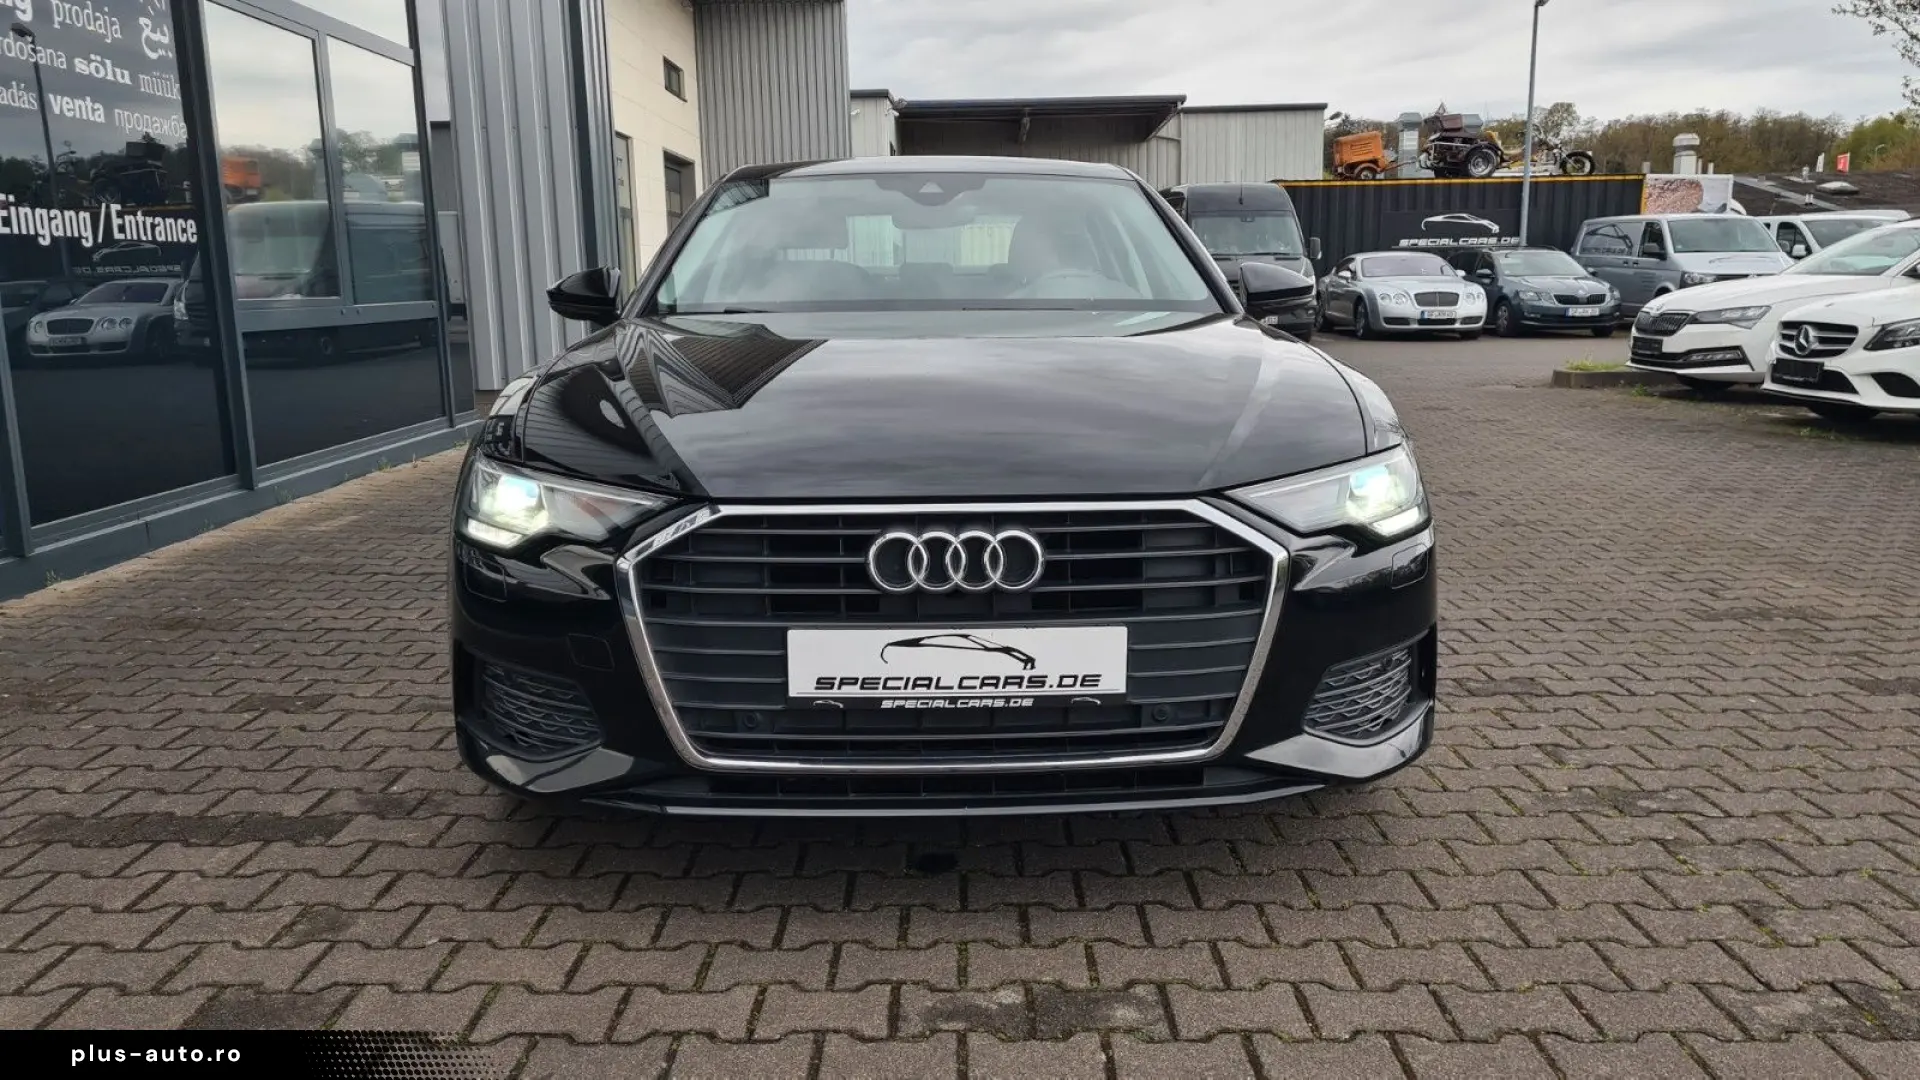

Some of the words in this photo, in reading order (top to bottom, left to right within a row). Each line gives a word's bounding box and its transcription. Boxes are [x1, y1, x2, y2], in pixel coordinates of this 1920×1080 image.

[51, 0, 122, 43] prodaja
[0, 31, 67, 70] došana
[74, 53, 132, 85] sölu
[138, 71, 181, 100] müük
[48, 93, 106, 124] venta
[114, 108, 188, 139] продажба
[814, 673, 1102, 691] SPECIALCARS.DE
[881, 697, 1035, 709] SPECIALCARS.DE
